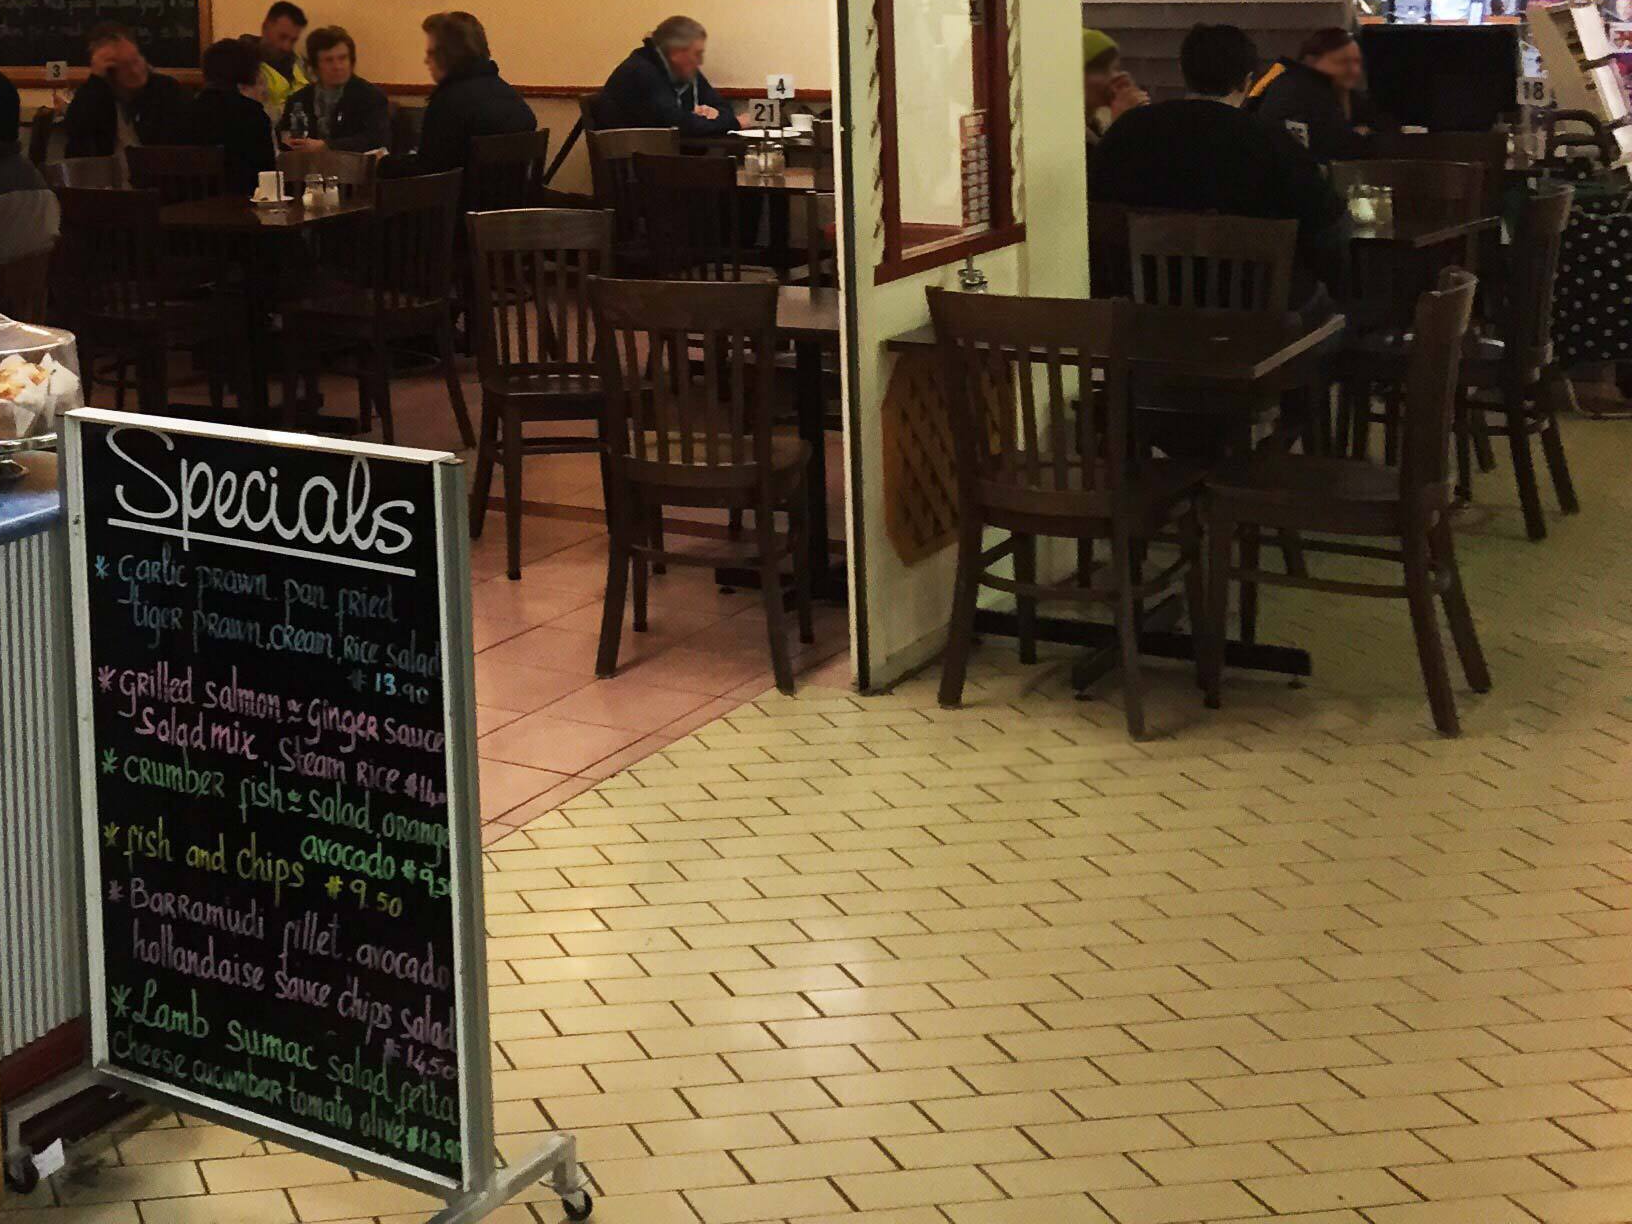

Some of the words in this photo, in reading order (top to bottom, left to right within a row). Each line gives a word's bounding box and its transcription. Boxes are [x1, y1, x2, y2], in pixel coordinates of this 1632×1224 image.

[754, 103, 775, 123] 21
[1523, 81, 1545, 101] 18
[106, 426, 417, 555] Specials
[202, 664, 283, 723] salmon
[238, 763, 286, 824] fish
[123, 815, 174, 873] fish
[186, 832, 229, 875] and
[236, 831, 306, 908] chips
[131, 977, 209, 1039] Lamb
